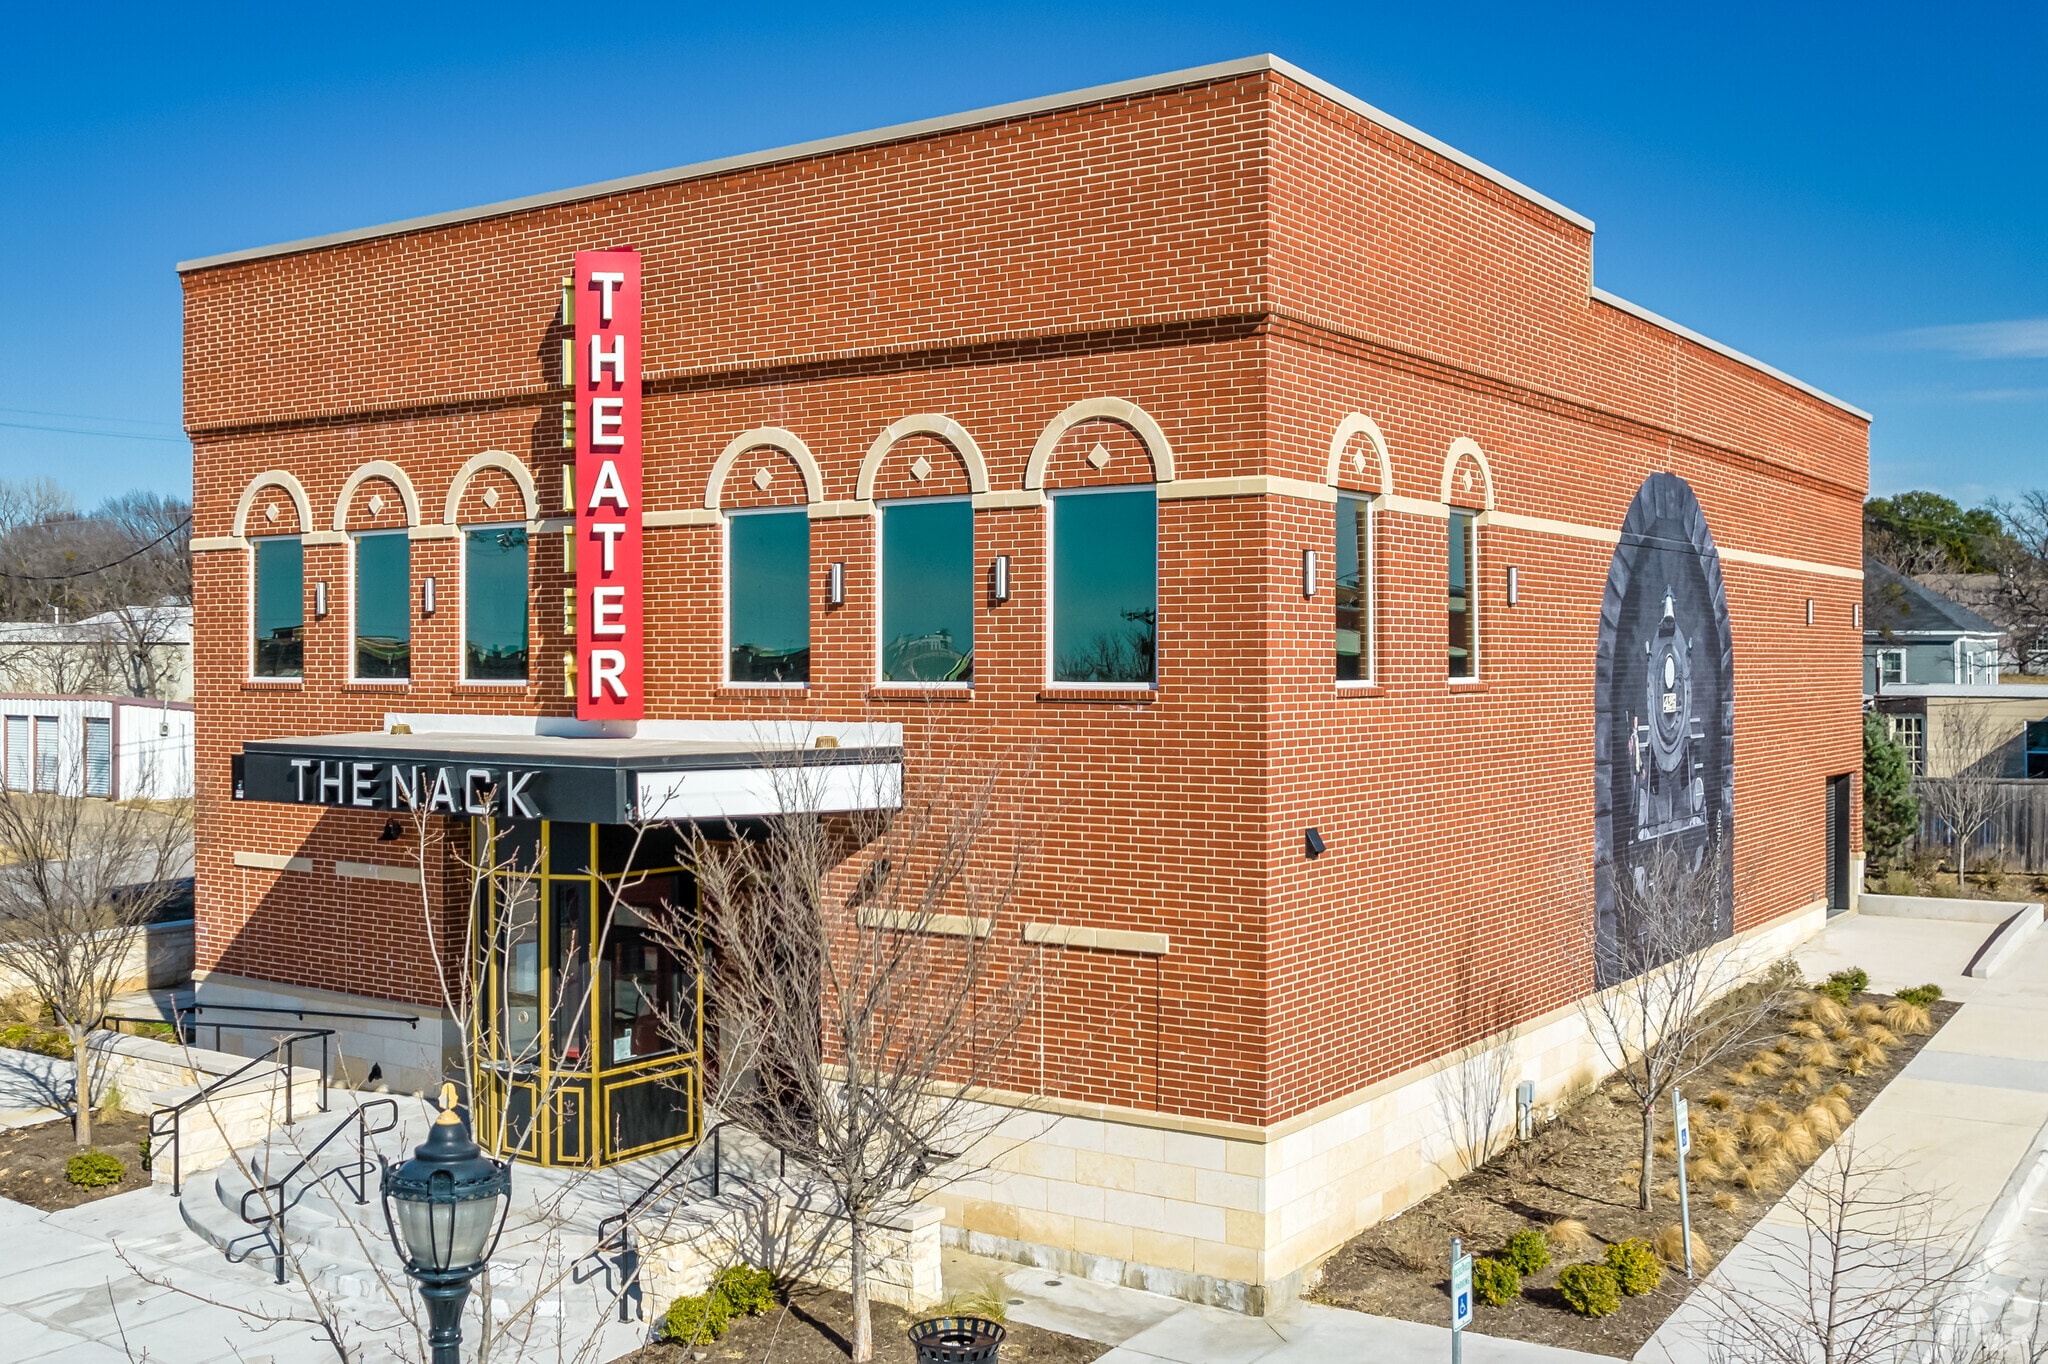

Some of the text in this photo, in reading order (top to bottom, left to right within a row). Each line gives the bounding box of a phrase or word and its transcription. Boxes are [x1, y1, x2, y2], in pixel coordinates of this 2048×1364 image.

[588, 272, 629, 699] THEATER
[291, 759, 541, 820] THE NACK
